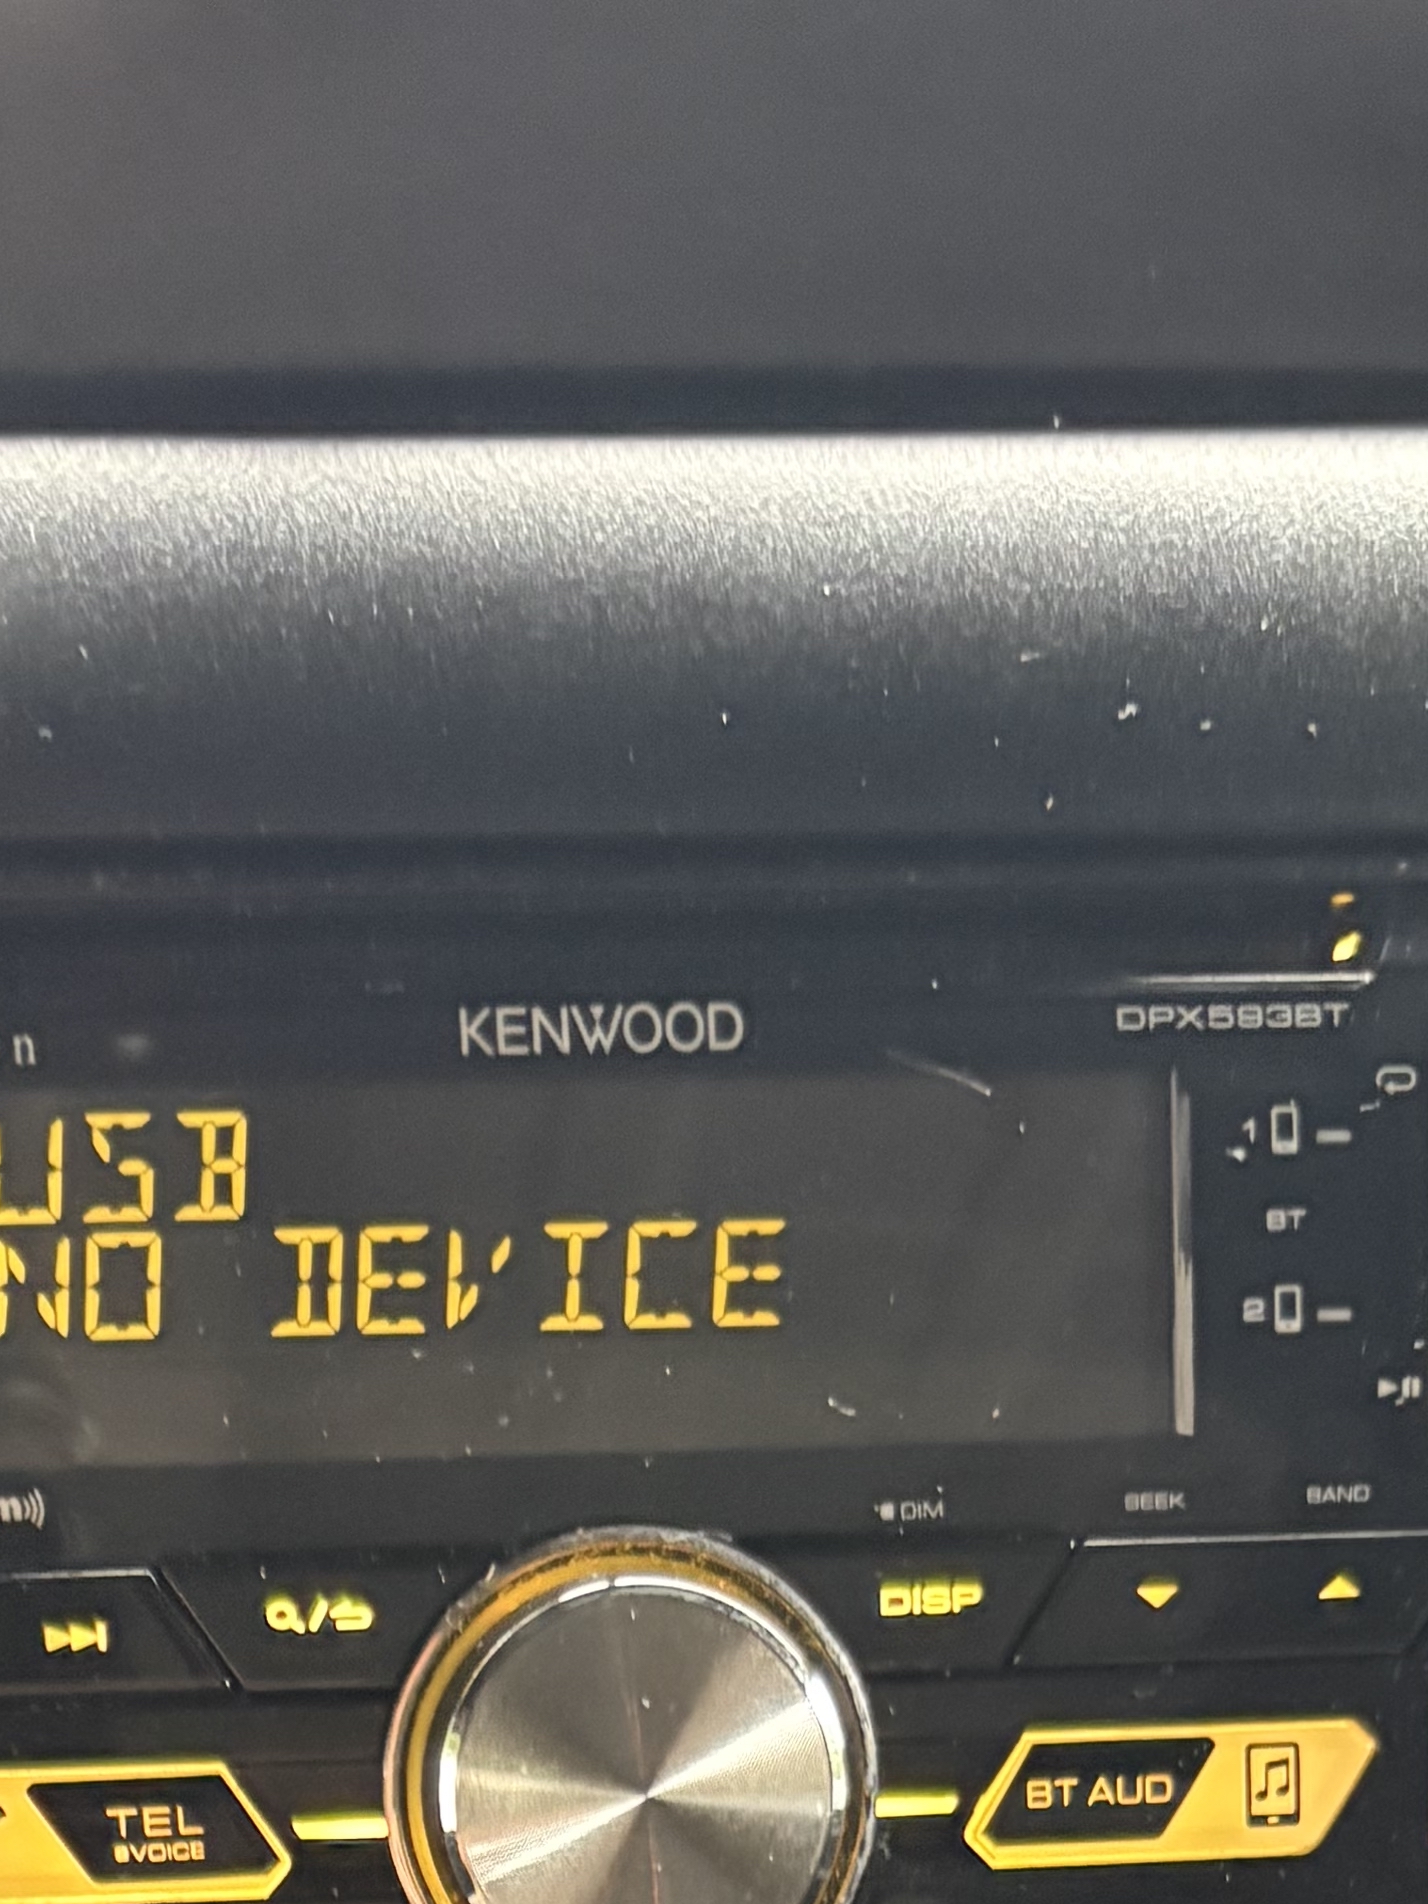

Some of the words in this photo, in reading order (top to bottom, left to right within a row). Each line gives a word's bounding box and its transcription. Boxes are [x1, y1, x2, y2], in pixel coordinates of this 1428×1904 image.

[459, 1001, 743, 1055] KENWOOD
[1266, 1208, 1306, 1231] BT
[271, 1220, 785, 1337] DEVICE
[1244, 1299, 1264, 1323] 2
[900, 1500, 943, 1520] DIM
[1307, 1484, 1370, 1504] BAND
[879, 1581, 982, 1616] DISP
[1026, 1777, 1078, 1809] BT
[1087, 1773, 1173, 1806] AUD
[105, 1805, 204, 1838] TEL
